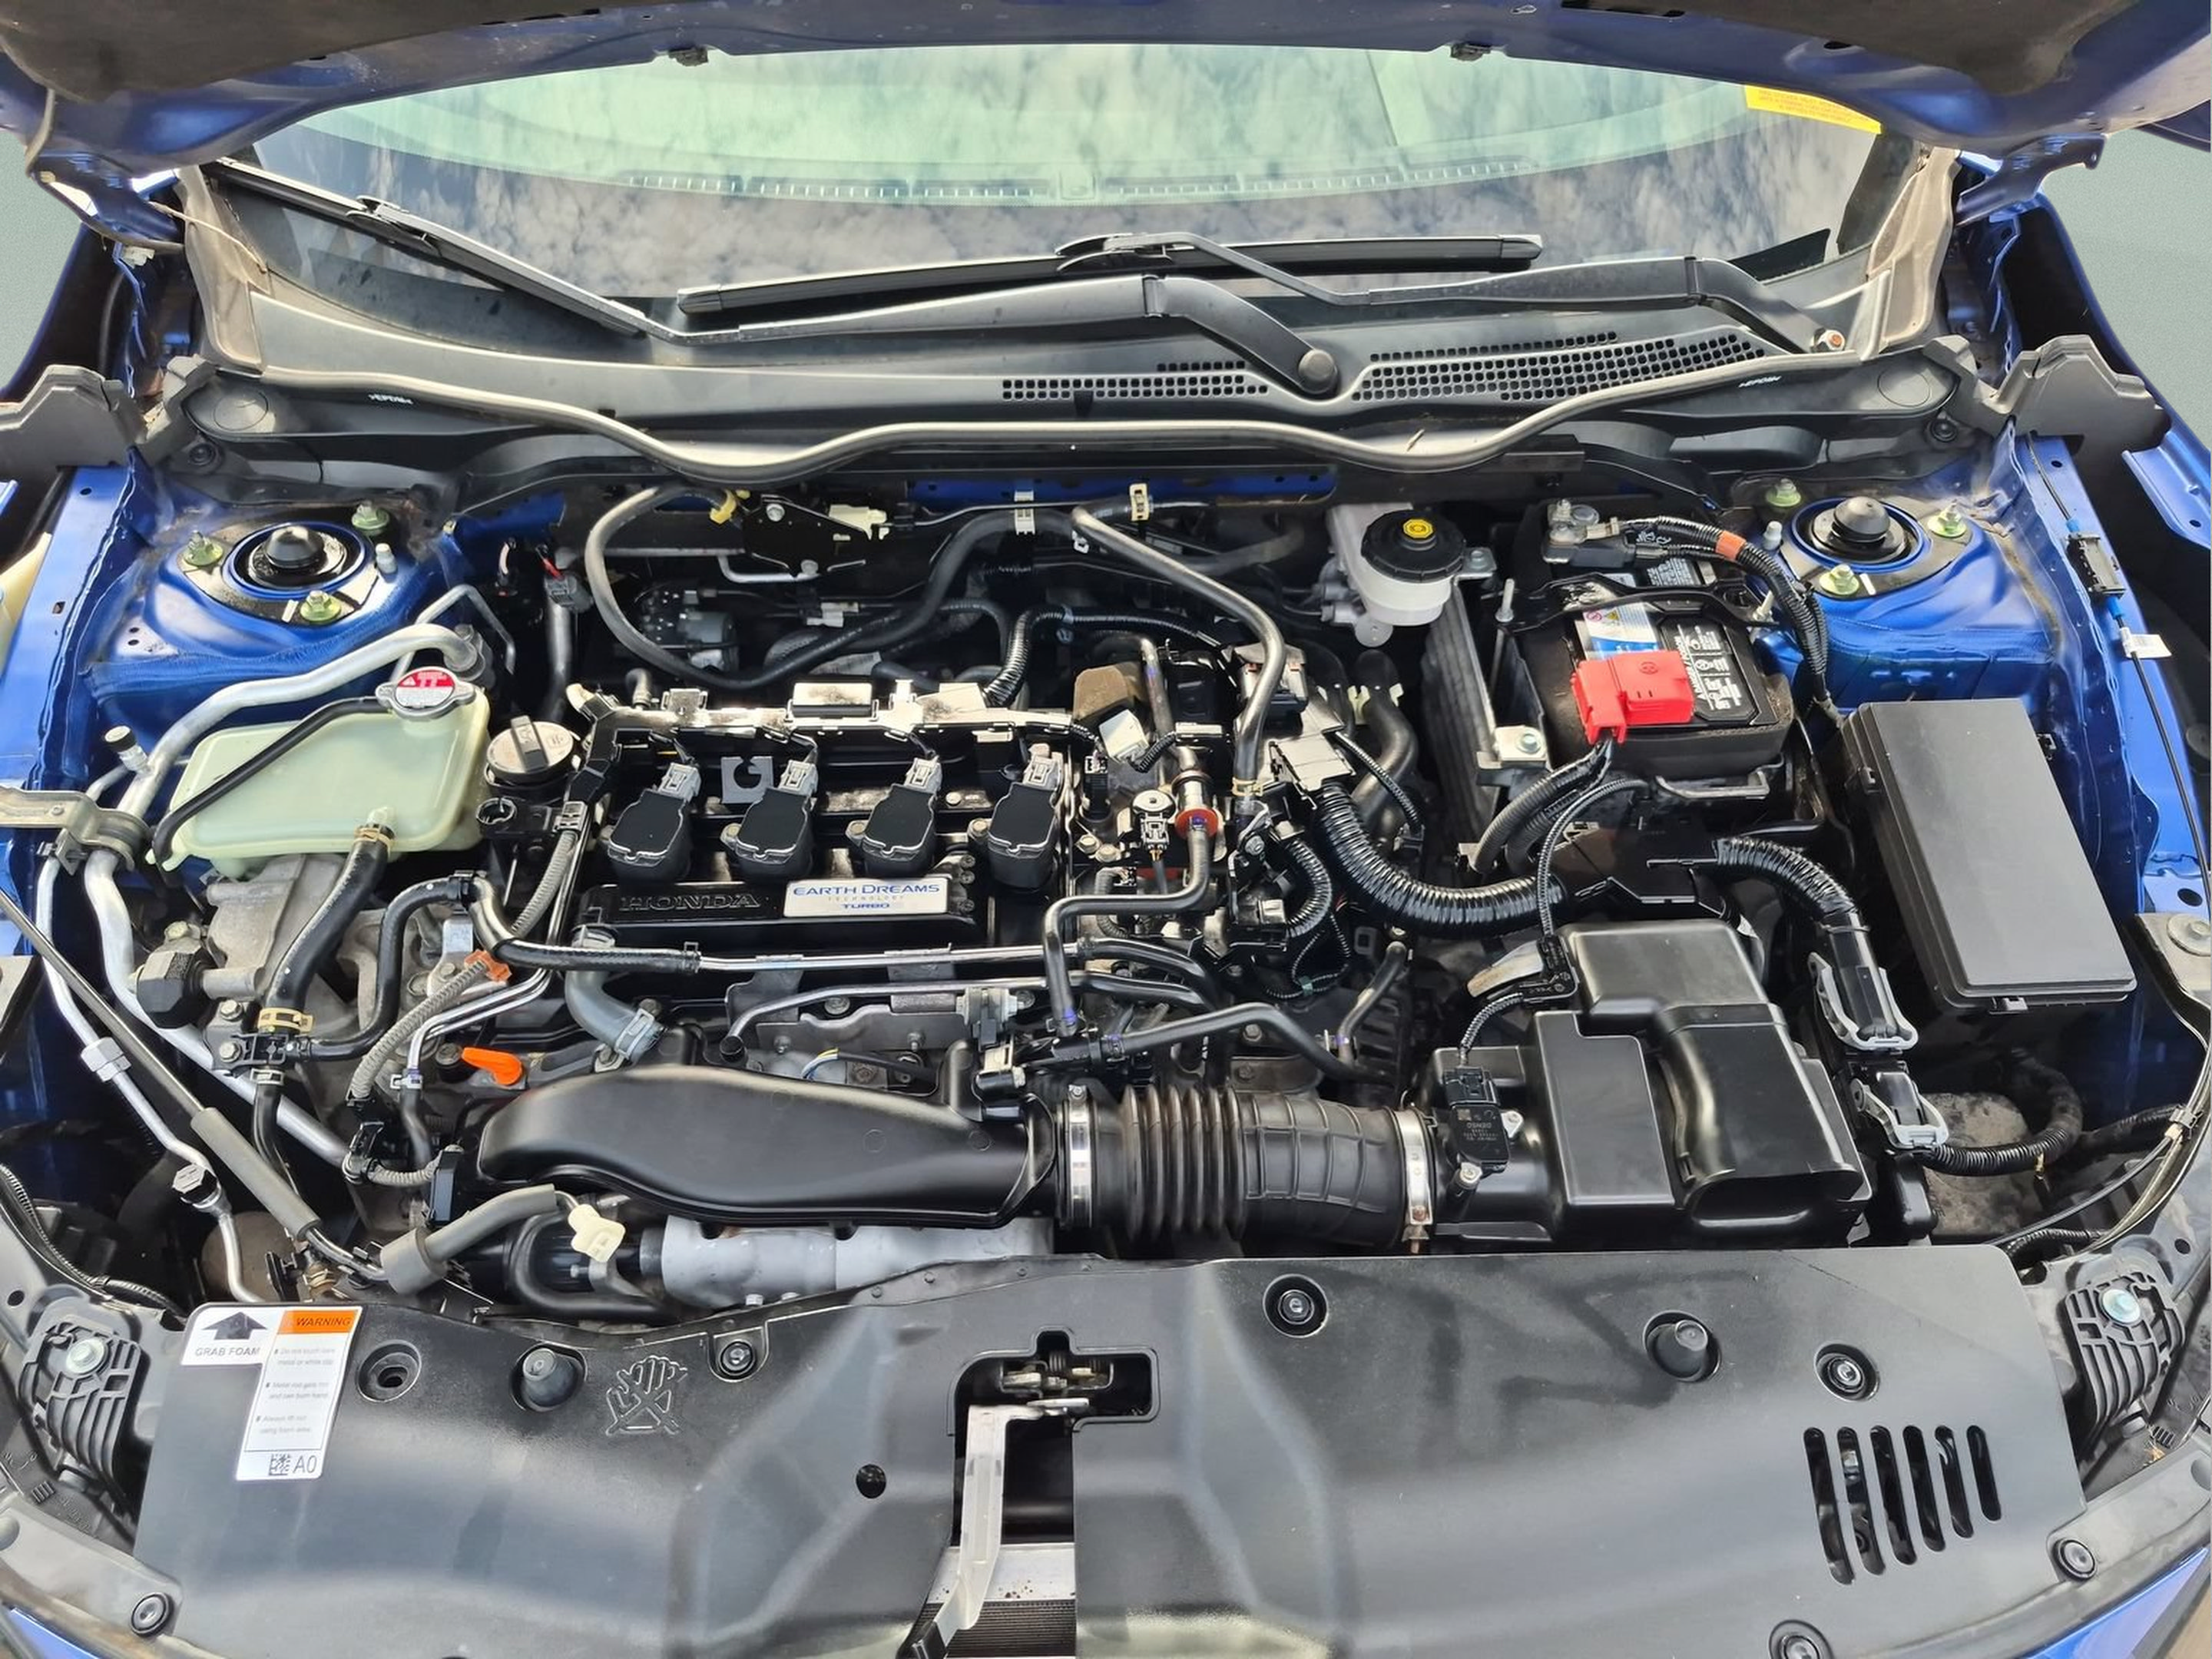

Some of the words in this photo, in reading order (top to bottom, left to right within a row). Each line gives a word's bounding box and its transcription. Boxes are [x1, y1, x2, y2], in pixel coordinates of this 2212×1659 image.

[793, 886, 856, 896] EARTH
[862, 884, 940, 894] DREAMS
[619, 893, 760, 910] HONDA
[296, 1316, 351, 1327] WARNING
[195, 1347, 225, 1356] GRAB
[228, 1346, 260, 1356] FOAM
[293, 1455, 317, 1474] A0
